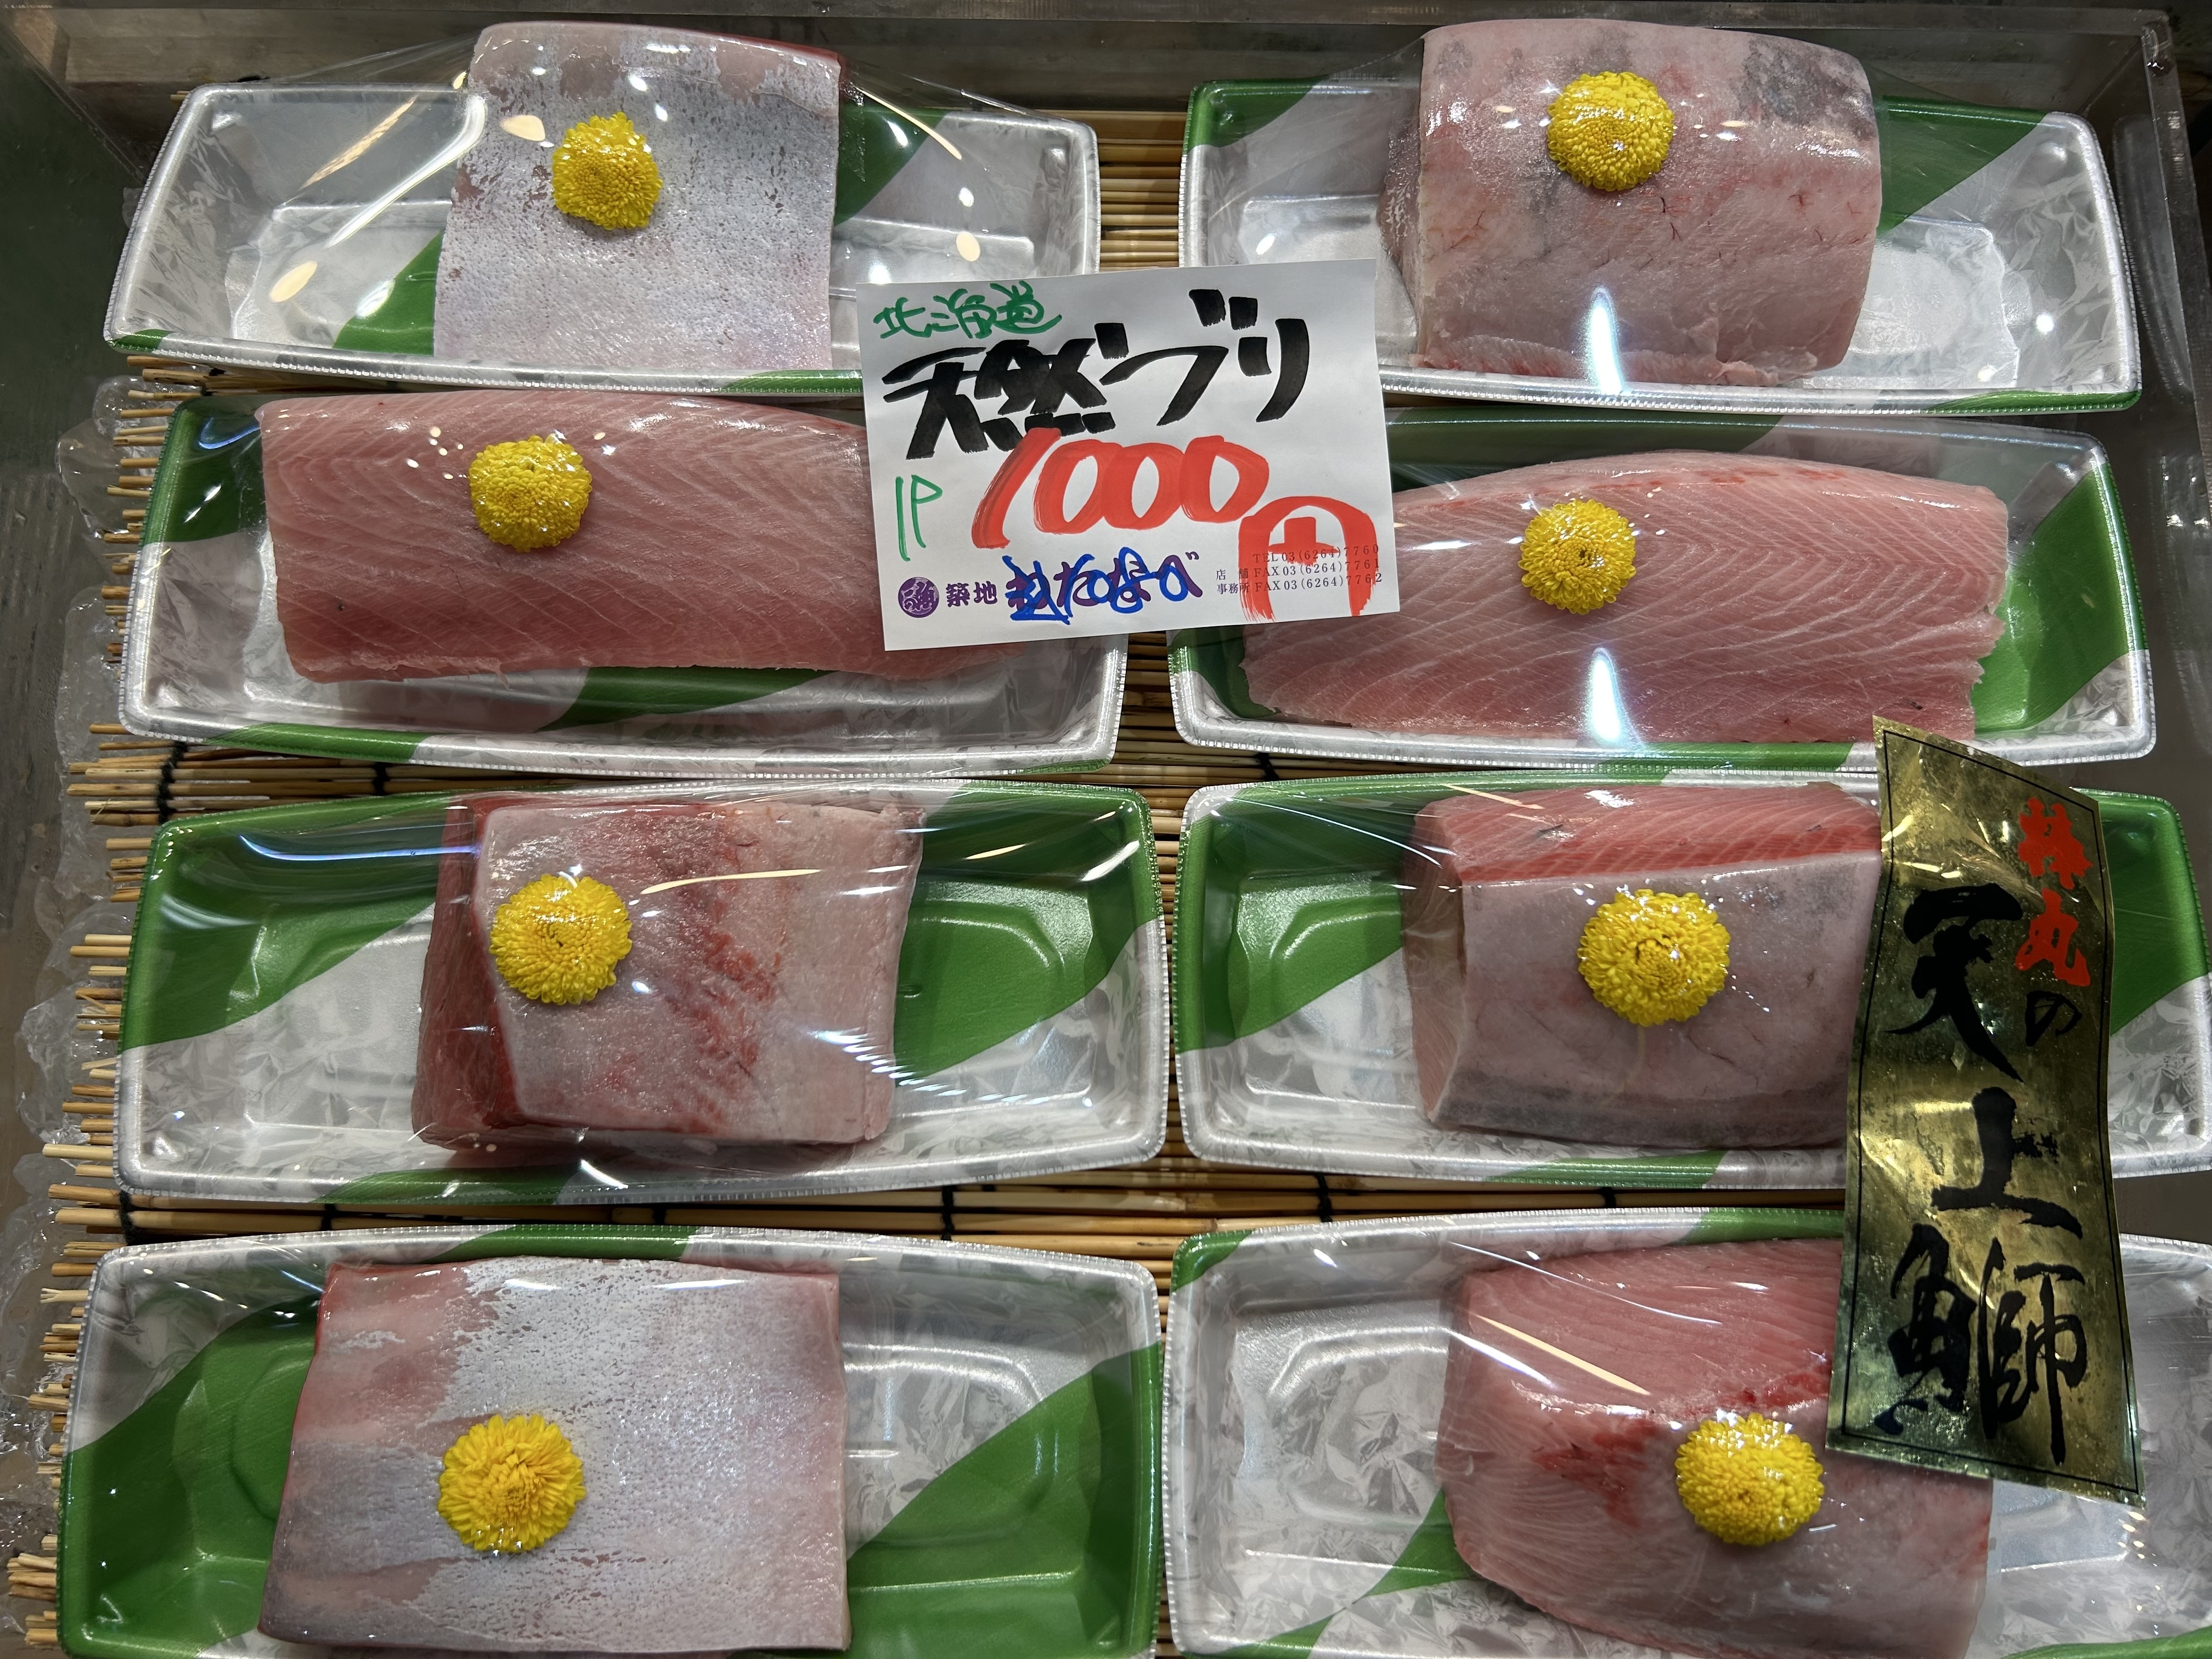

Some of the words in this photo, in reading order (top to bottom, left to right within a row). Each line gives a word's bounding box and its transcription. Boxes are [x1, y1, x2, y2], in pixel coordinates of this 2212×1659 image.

[874, 281, 1062, 338] 北海道
[883, 289, 1309, 459] 天然ブリ
[946, 581, 997, 607] 築地
[1216, 582, 1250, 595] 事務所
[1876, 883, 2088, 1465] 天上鰤
